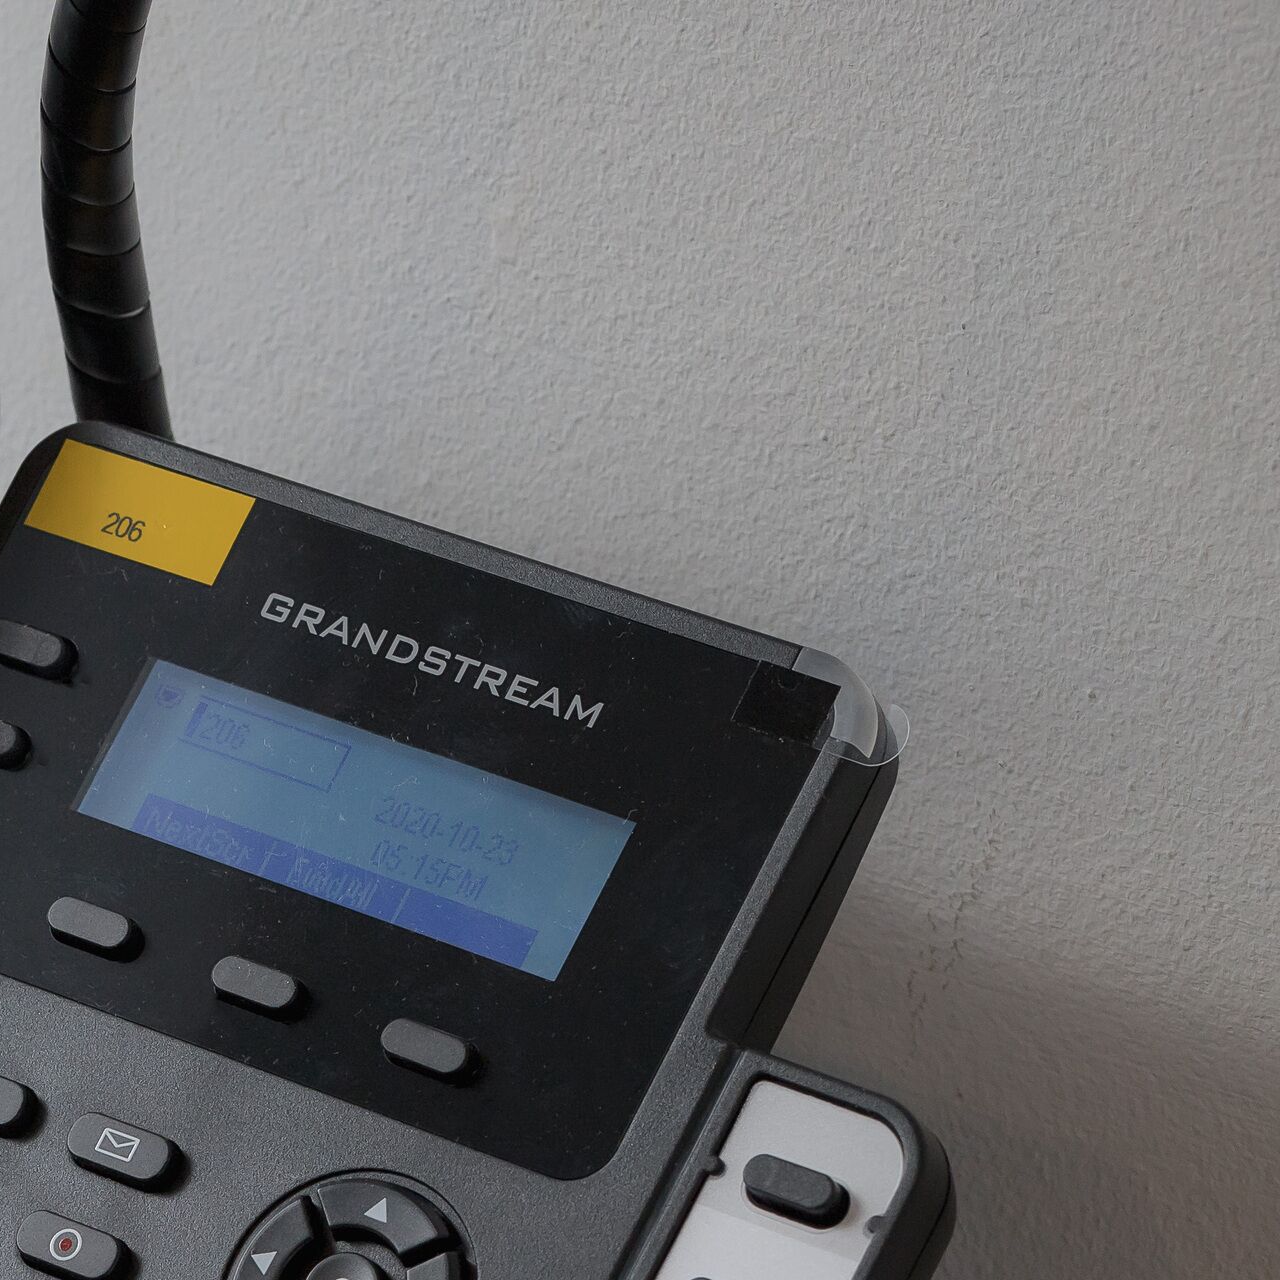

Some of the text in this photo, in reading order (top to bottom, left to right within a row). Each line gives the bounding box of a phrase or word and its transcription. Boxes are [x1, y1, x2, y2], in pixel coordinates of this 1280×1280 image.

[101, 512, 145, 543] 206
[260, 593, 604, 728] GRANDSTREAM
[199, 714, 251, 749] 206
[375, 797, 519, 866] 2020-10-23
